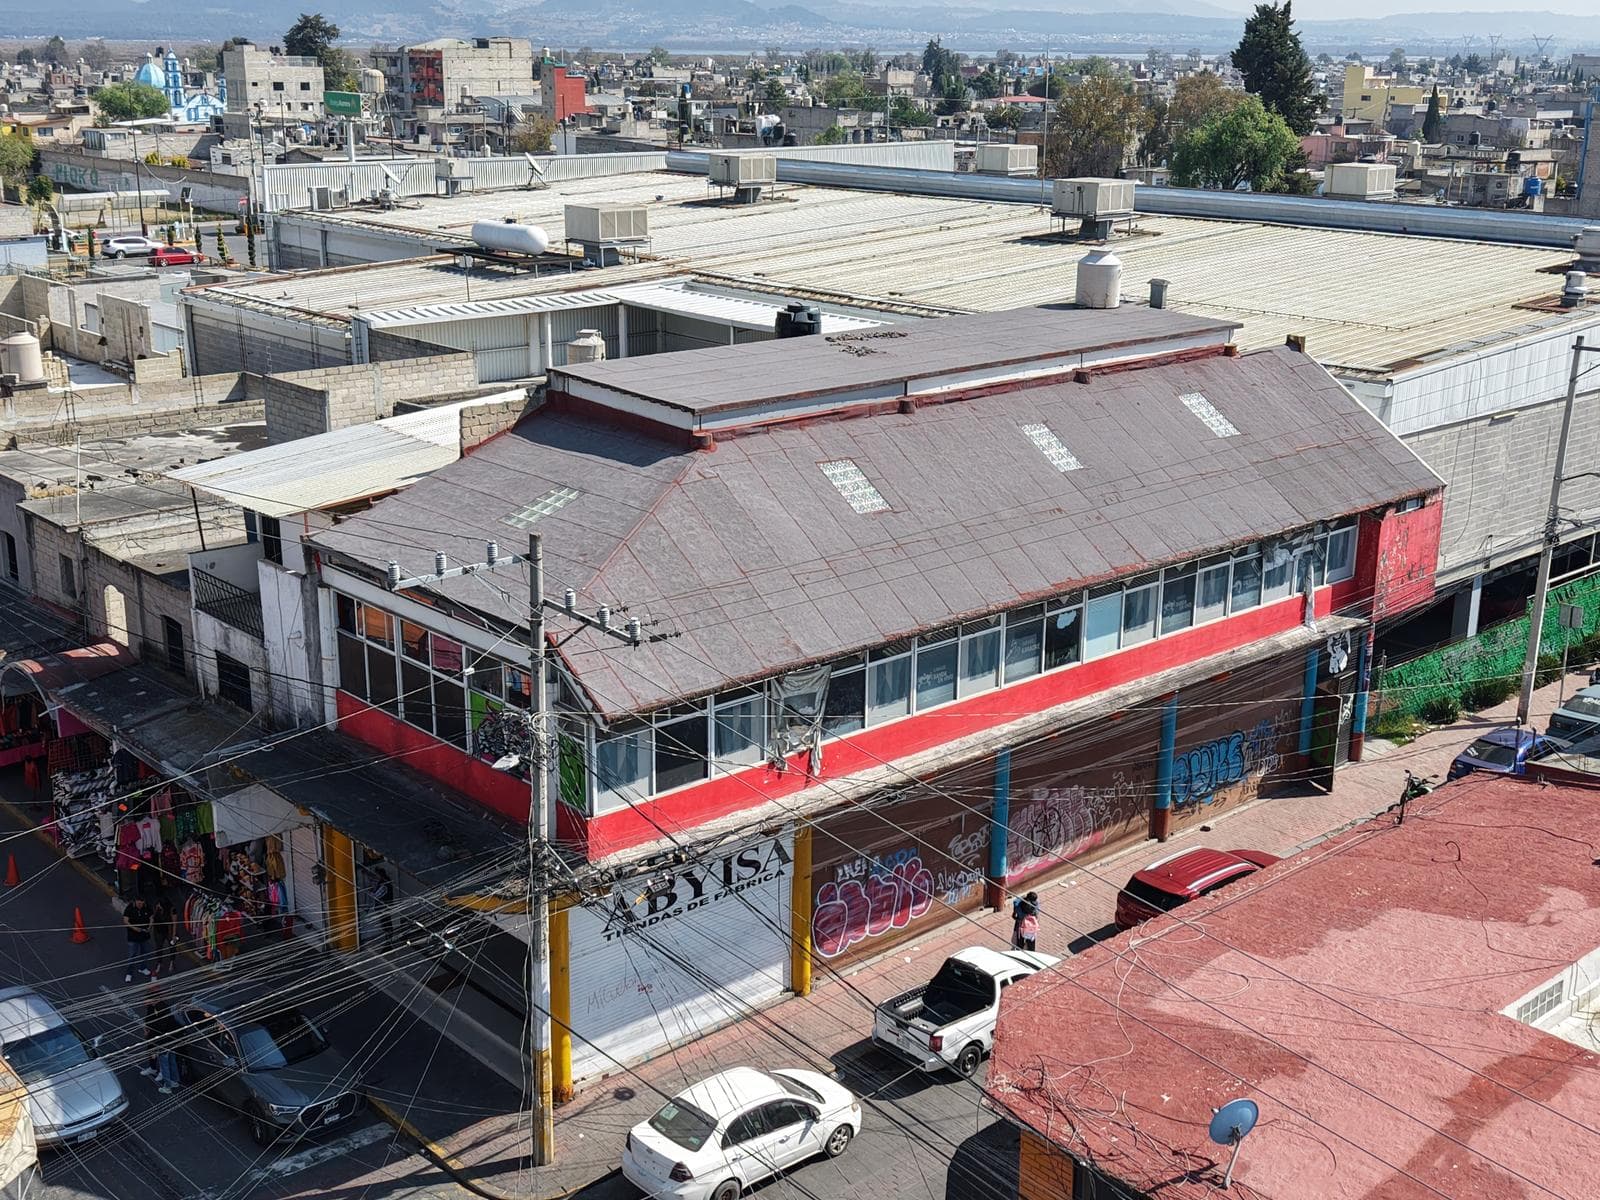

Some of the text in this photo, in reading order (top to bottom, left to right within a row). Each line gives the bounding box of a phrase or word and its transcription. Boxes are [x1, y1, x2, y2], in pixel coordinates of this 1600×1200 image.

[601, 838, 794, 934] ABYISA
[602, 869, 787, 942] TIENDAS DE FABRICA
